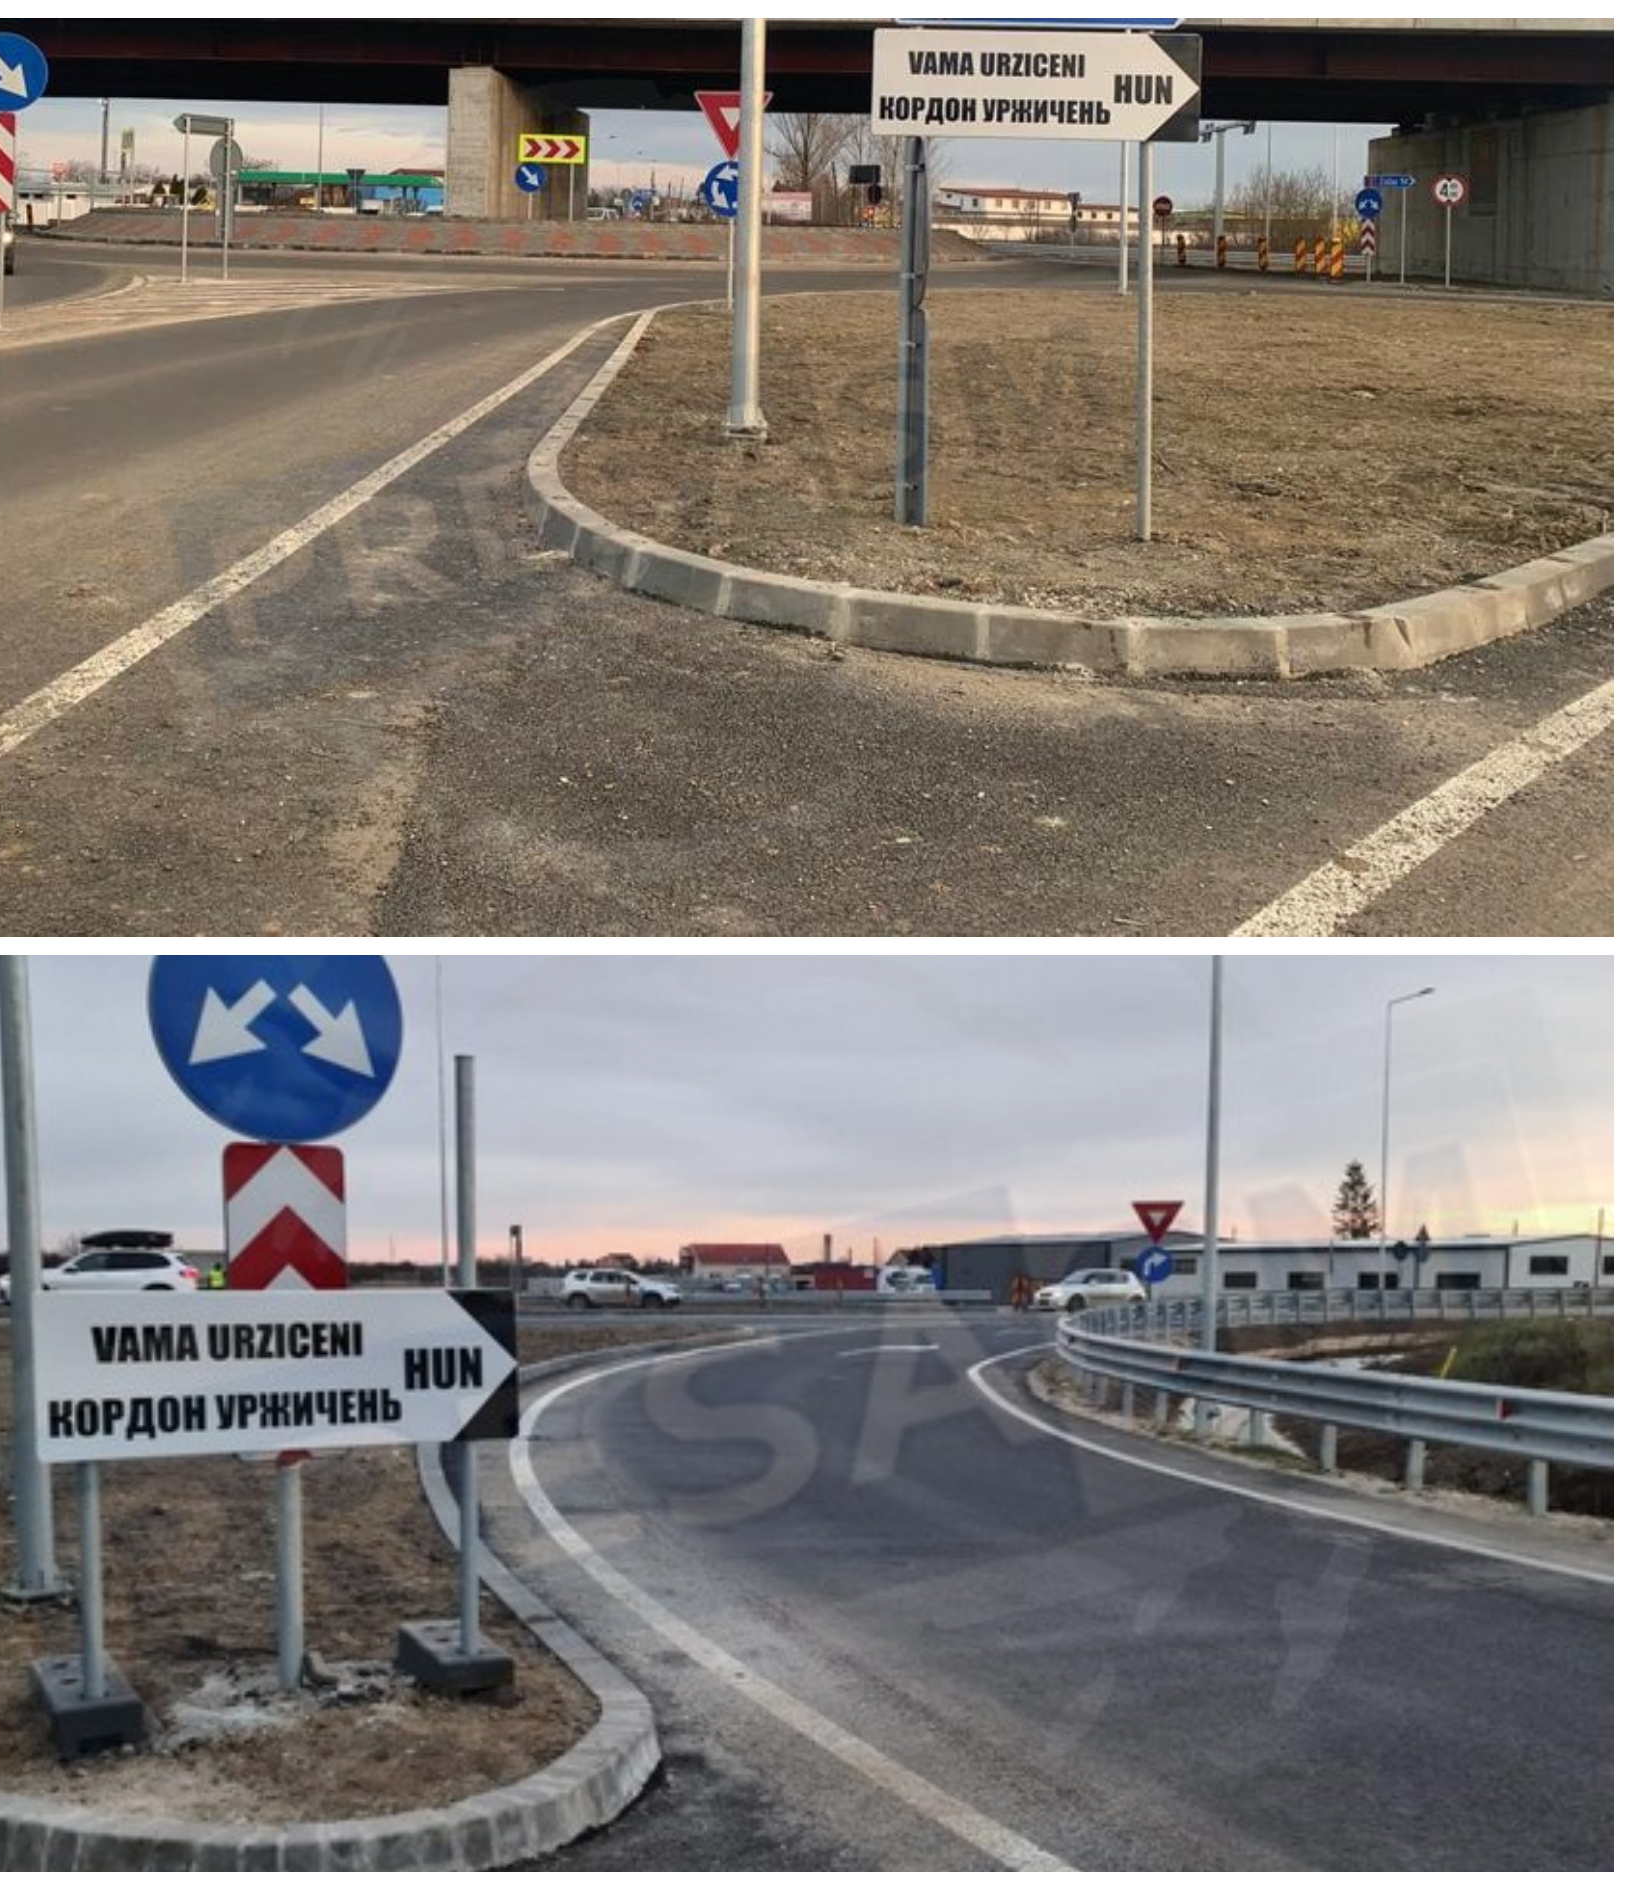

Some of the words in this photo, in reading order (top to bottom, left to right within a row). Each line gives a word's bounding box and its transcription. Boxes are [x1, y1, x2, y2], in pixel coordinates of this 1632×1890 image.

[909, 51, 974, 75] VAMA
[981, 53, 1085, 78] URZICENI
[1114, 75, 1172, 104] HUN
[880, 97, 976, 124] КОРДОН
[983, 99, 1110, 124] УРЖИЧЕНЬ
[91, 1325, 199, 1363] VAMA
[208, 1323, 362, 1360] URZICENI
[404, 1347, 482, 1390] HUN
[49, 1395, 206, 1440] КОРДОН
[216, 1389, 401, 1429] УРЖИЧЕНЬ
